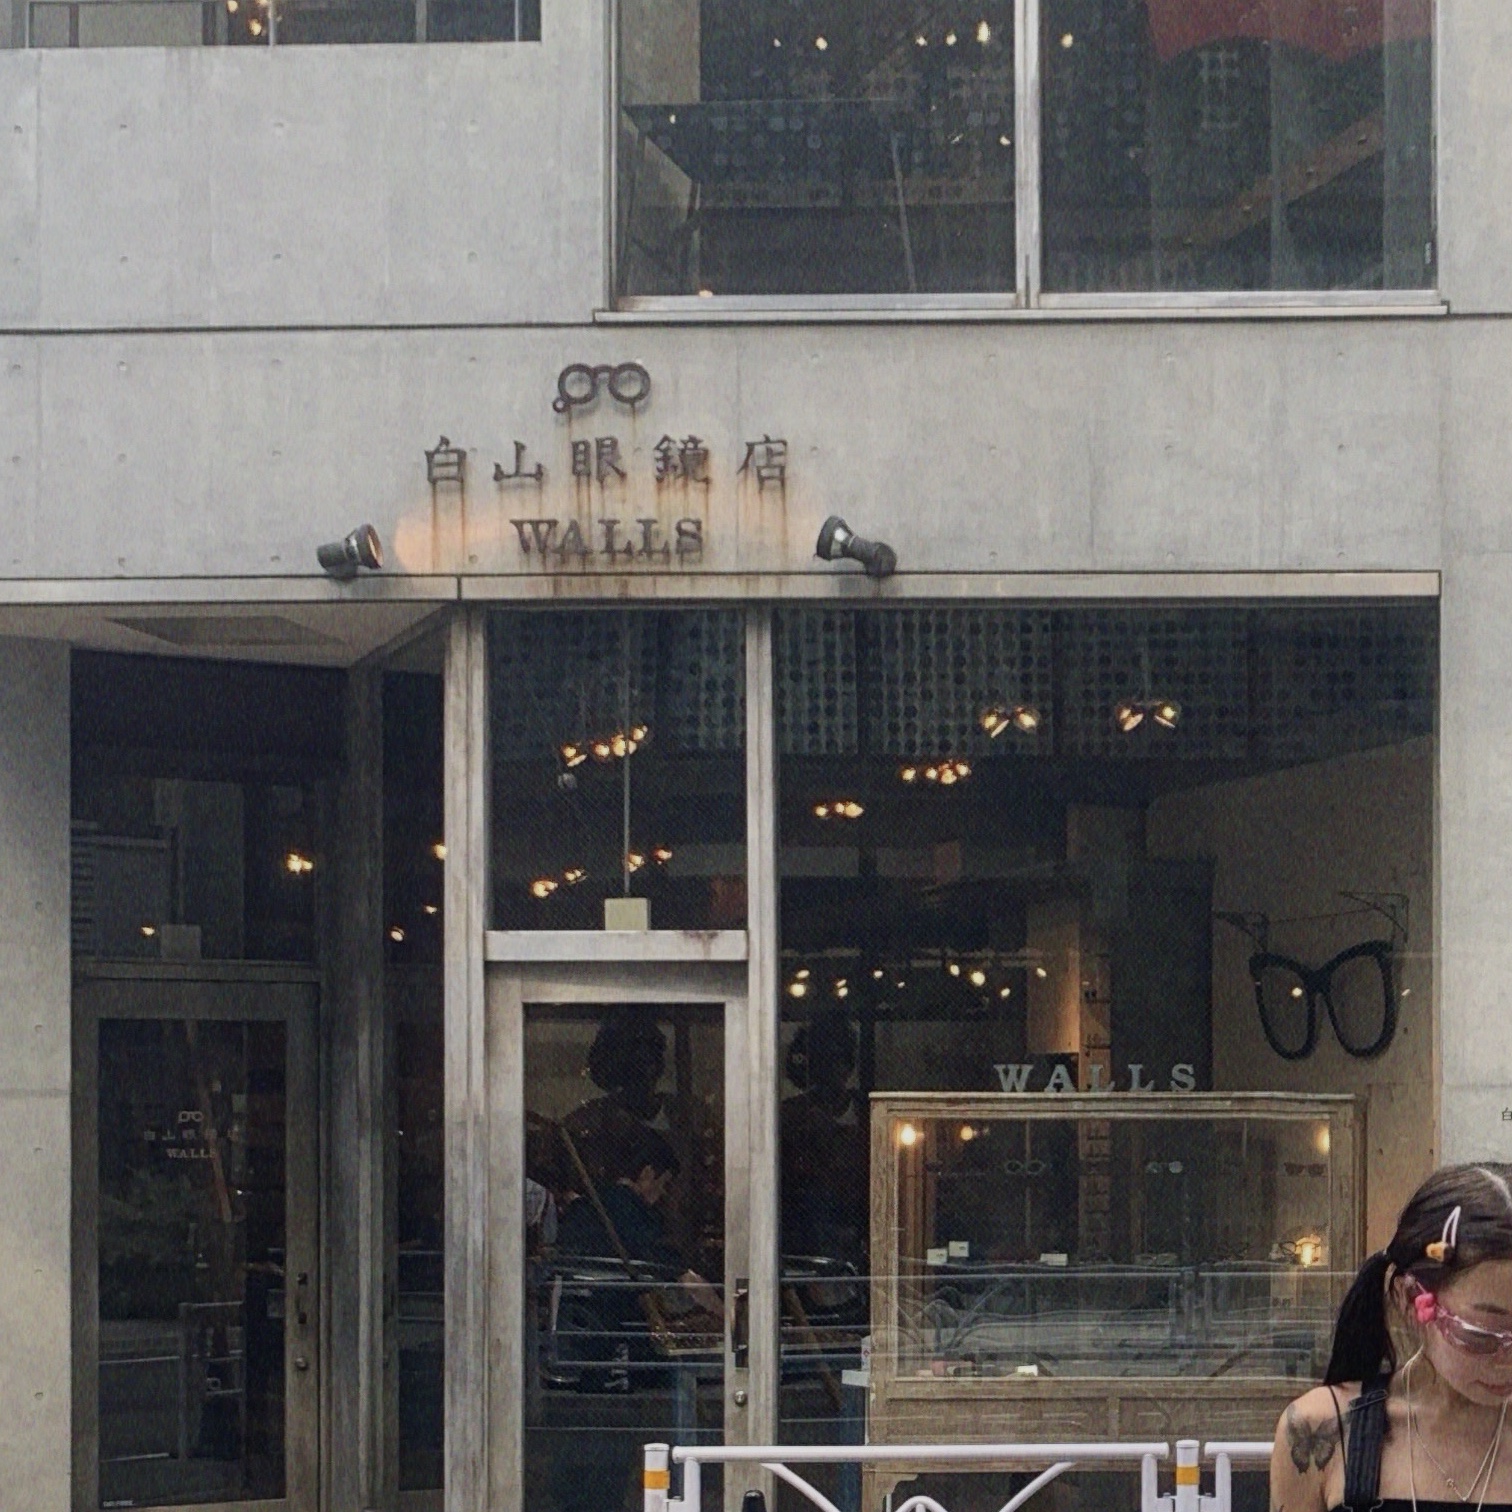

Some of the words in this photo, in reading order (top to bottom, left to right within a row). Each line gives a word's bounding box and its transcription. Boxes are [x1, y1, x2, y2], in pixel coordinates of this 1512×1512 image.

[424, 435, 788, 490] 白山眼鏡店
[509, 518, 702, 556] WALLS
[993, 1063, 1196, 1092] WALLS
